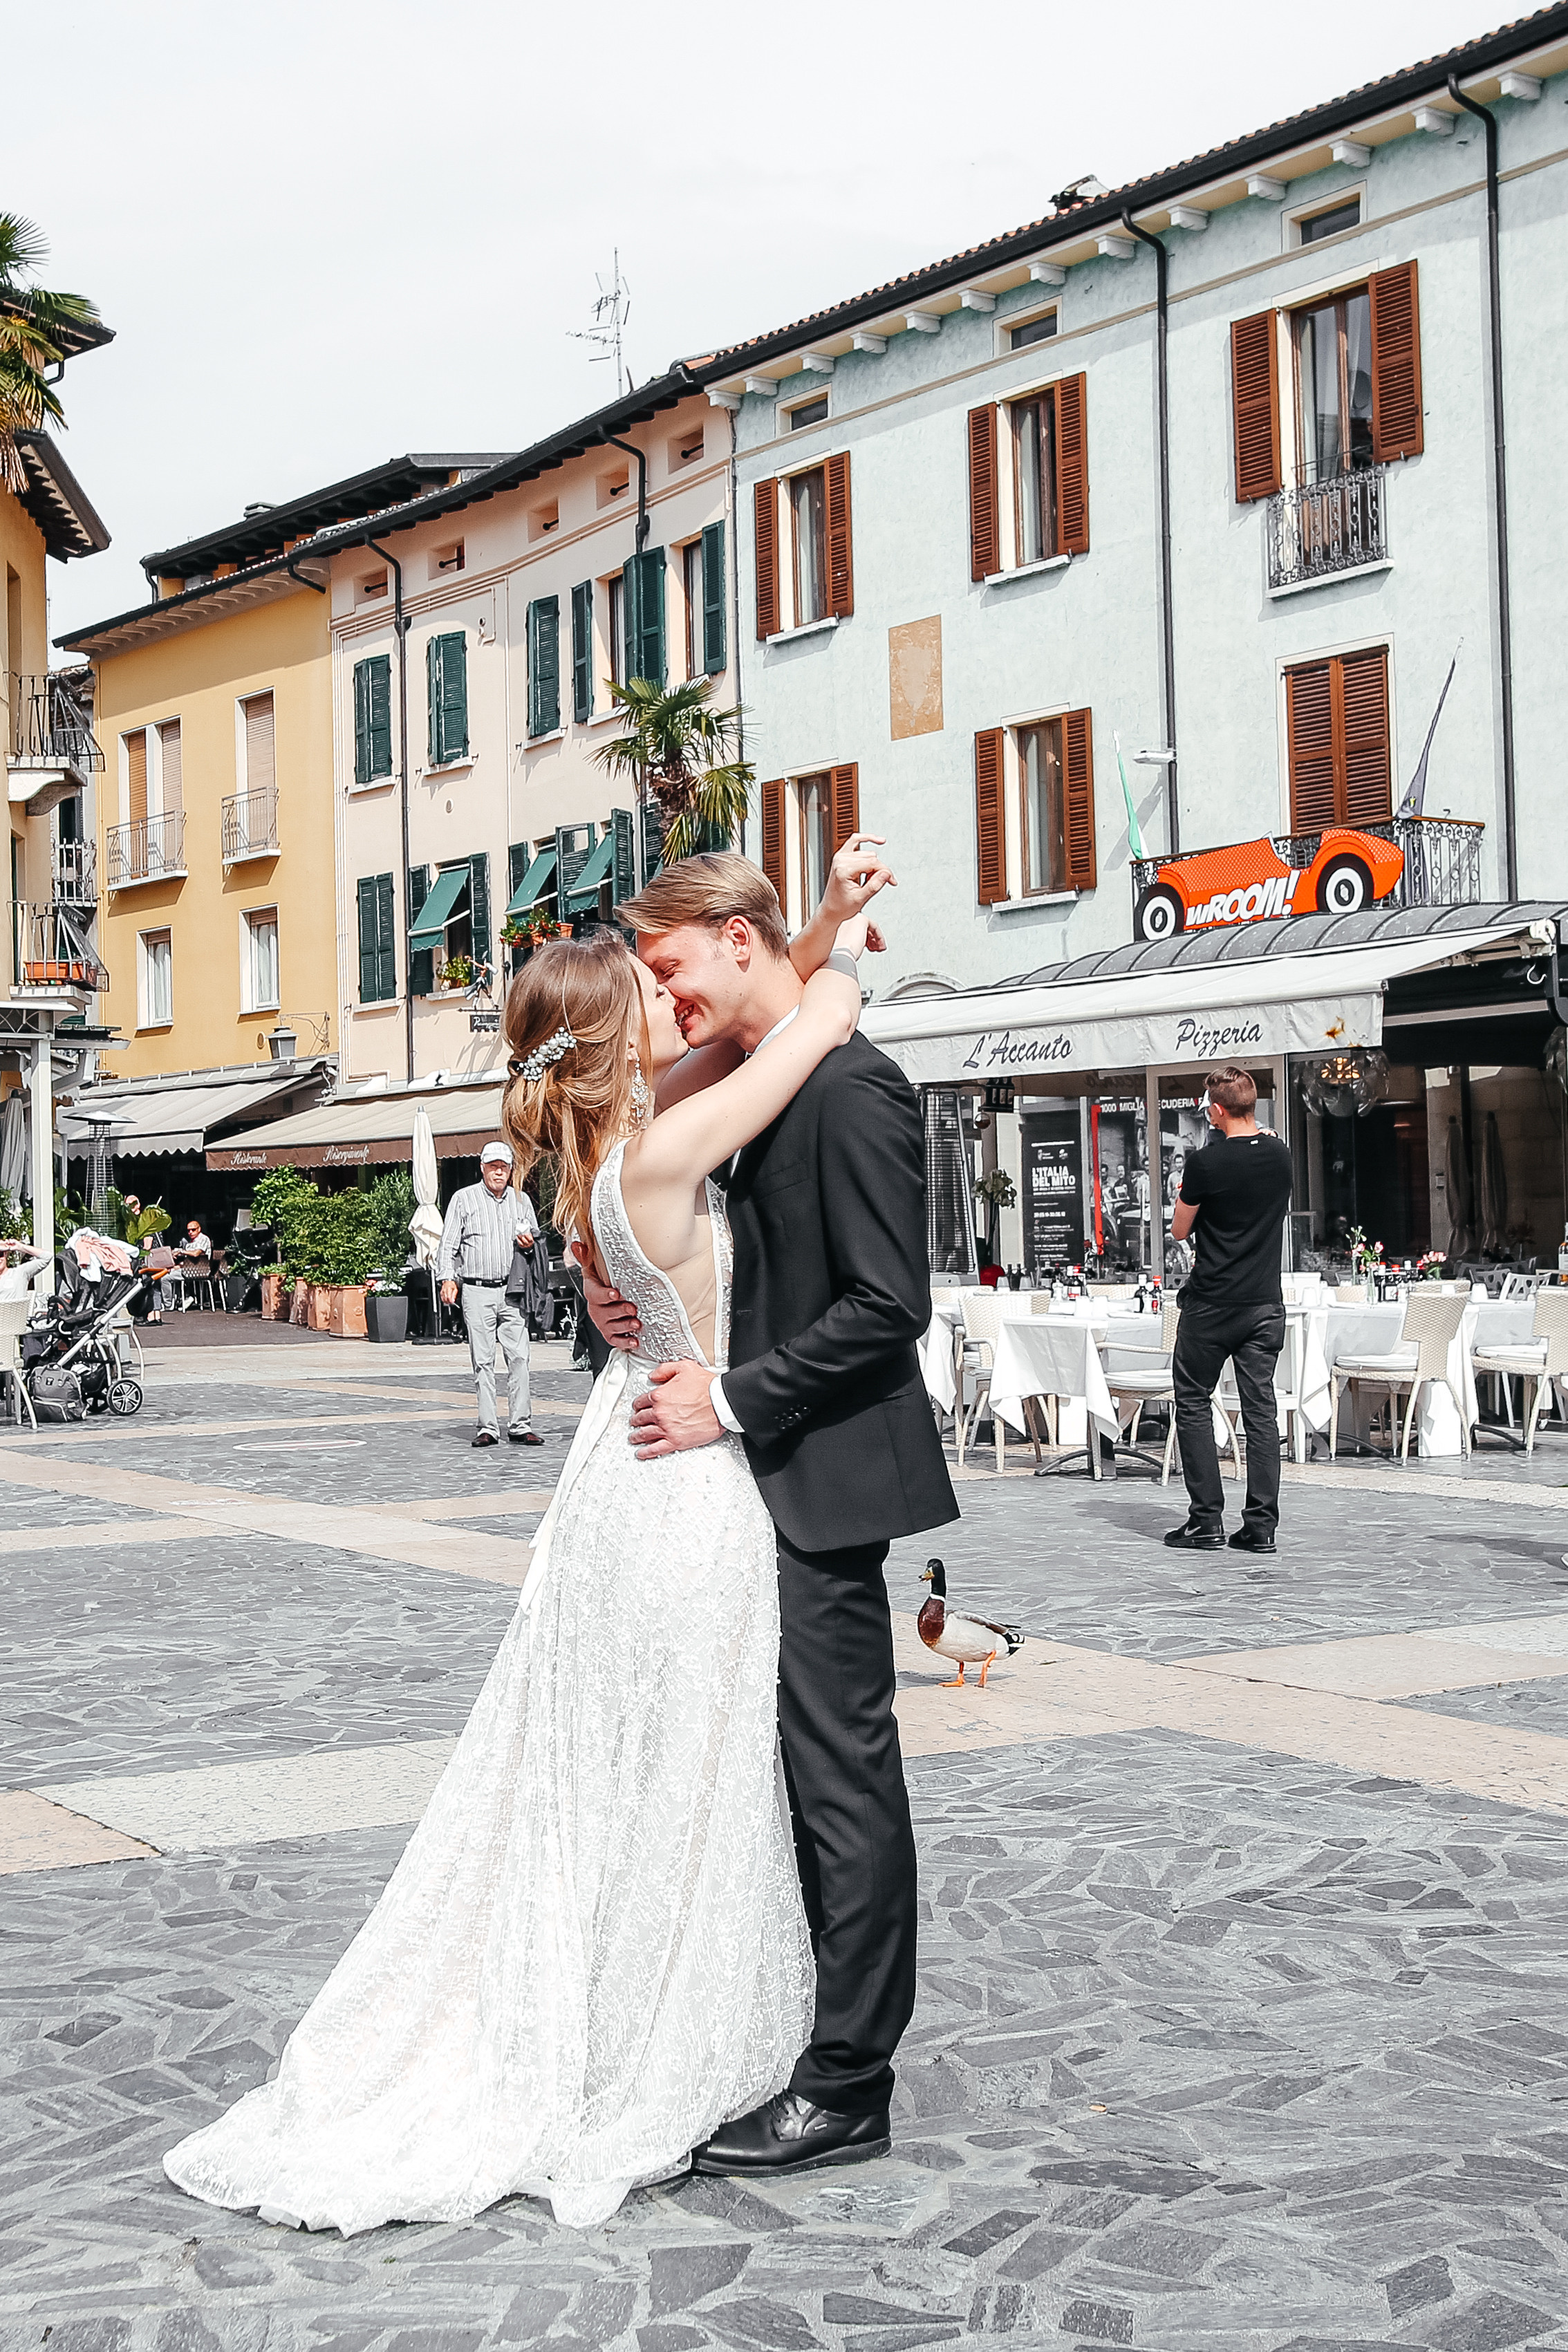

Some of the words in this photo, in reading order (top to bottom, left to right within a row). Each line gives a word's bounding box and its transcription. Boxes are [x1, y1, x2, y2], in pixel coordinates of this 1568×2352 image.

[962, 1030, 1074, 1069] L'Accanto
[1175, 1018, 1264, 1058] Pizzeria
[1099, 1103, 1117, 1113] 1000
[1119, 1101, 1146, 1112] MIGLIA
[1157, 1097, 1195, 1110] CUDERIA
[230, 1150, 268, 1166] Ristorante
[1032, 1166, 1070, 1177] L'ITALIA
[1032, 1176, 1050, 1187] DEL
[1051, 1175, 1076, 1186] MITO
